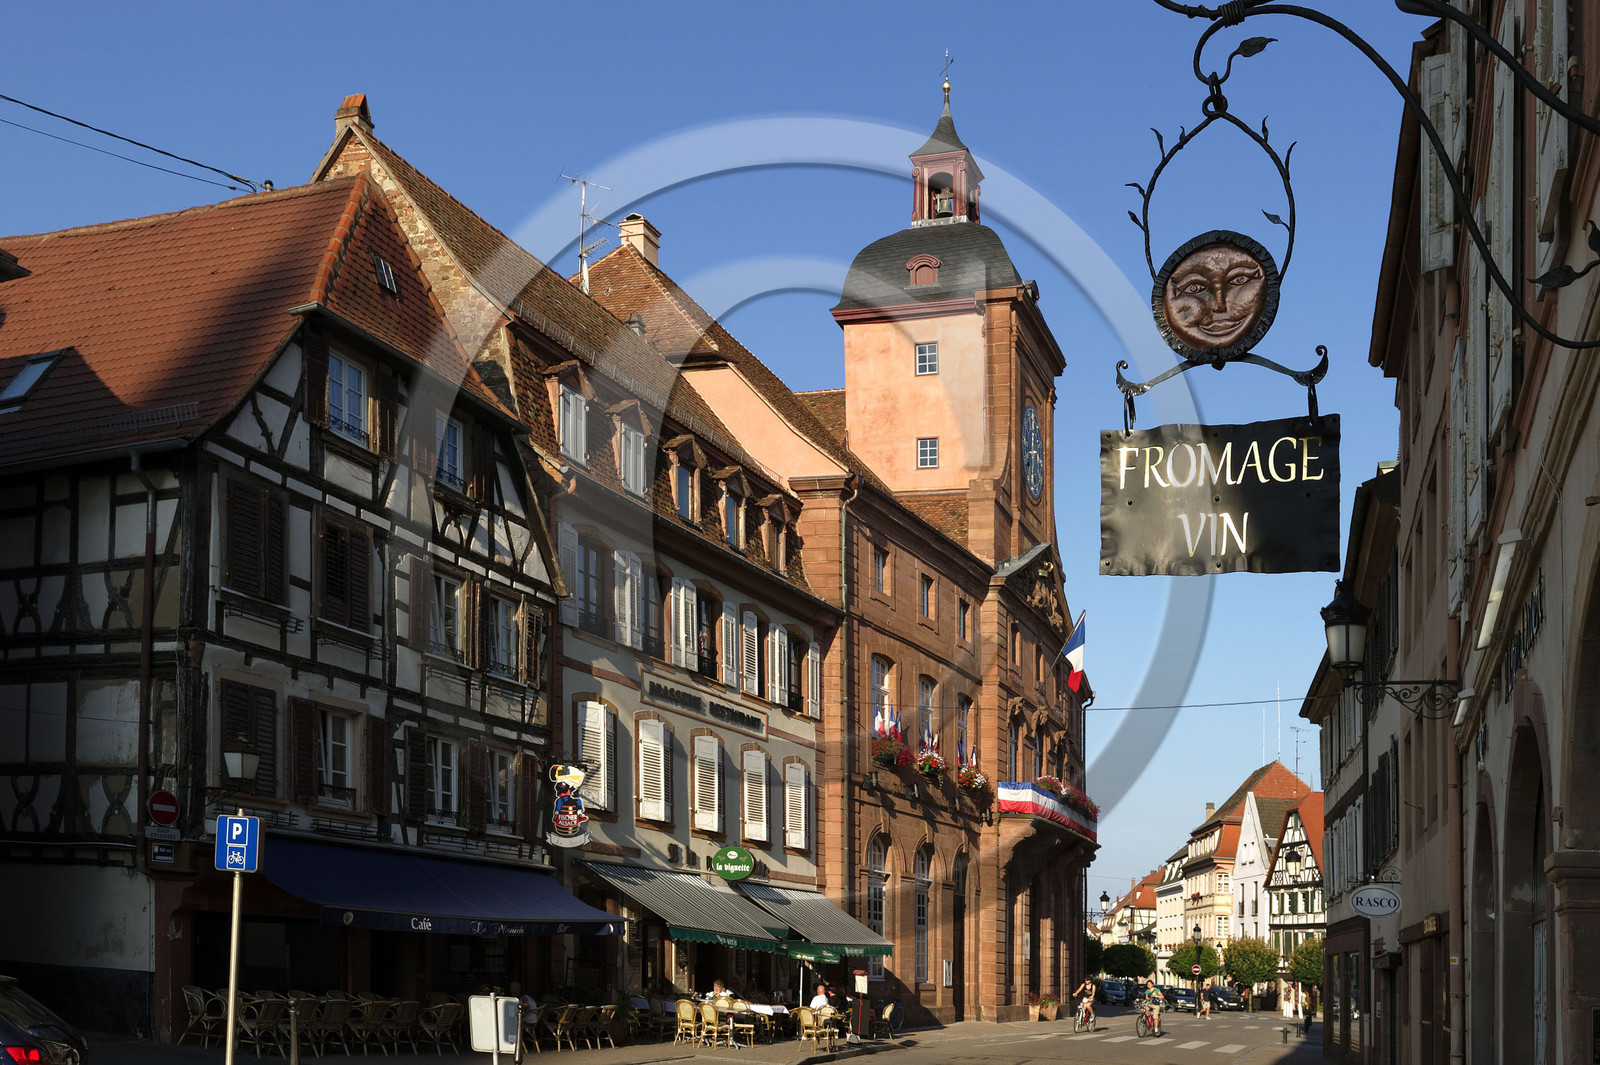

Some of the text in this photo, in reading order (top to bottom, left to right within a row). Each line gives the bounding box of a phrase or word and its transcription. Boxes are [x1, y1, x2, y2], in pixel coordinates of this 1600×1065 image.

[1117, 436, 1324, 490] FROMAGE
[1177, 511, 1249, 558] VIN
[232, 822, 243, 840] P
[716, 862, 723, 871] la
[724, 863, 750, 873] vignette
[1355, 896, 1397, 908] RASCO
[410, 917, 432, 931] Café
